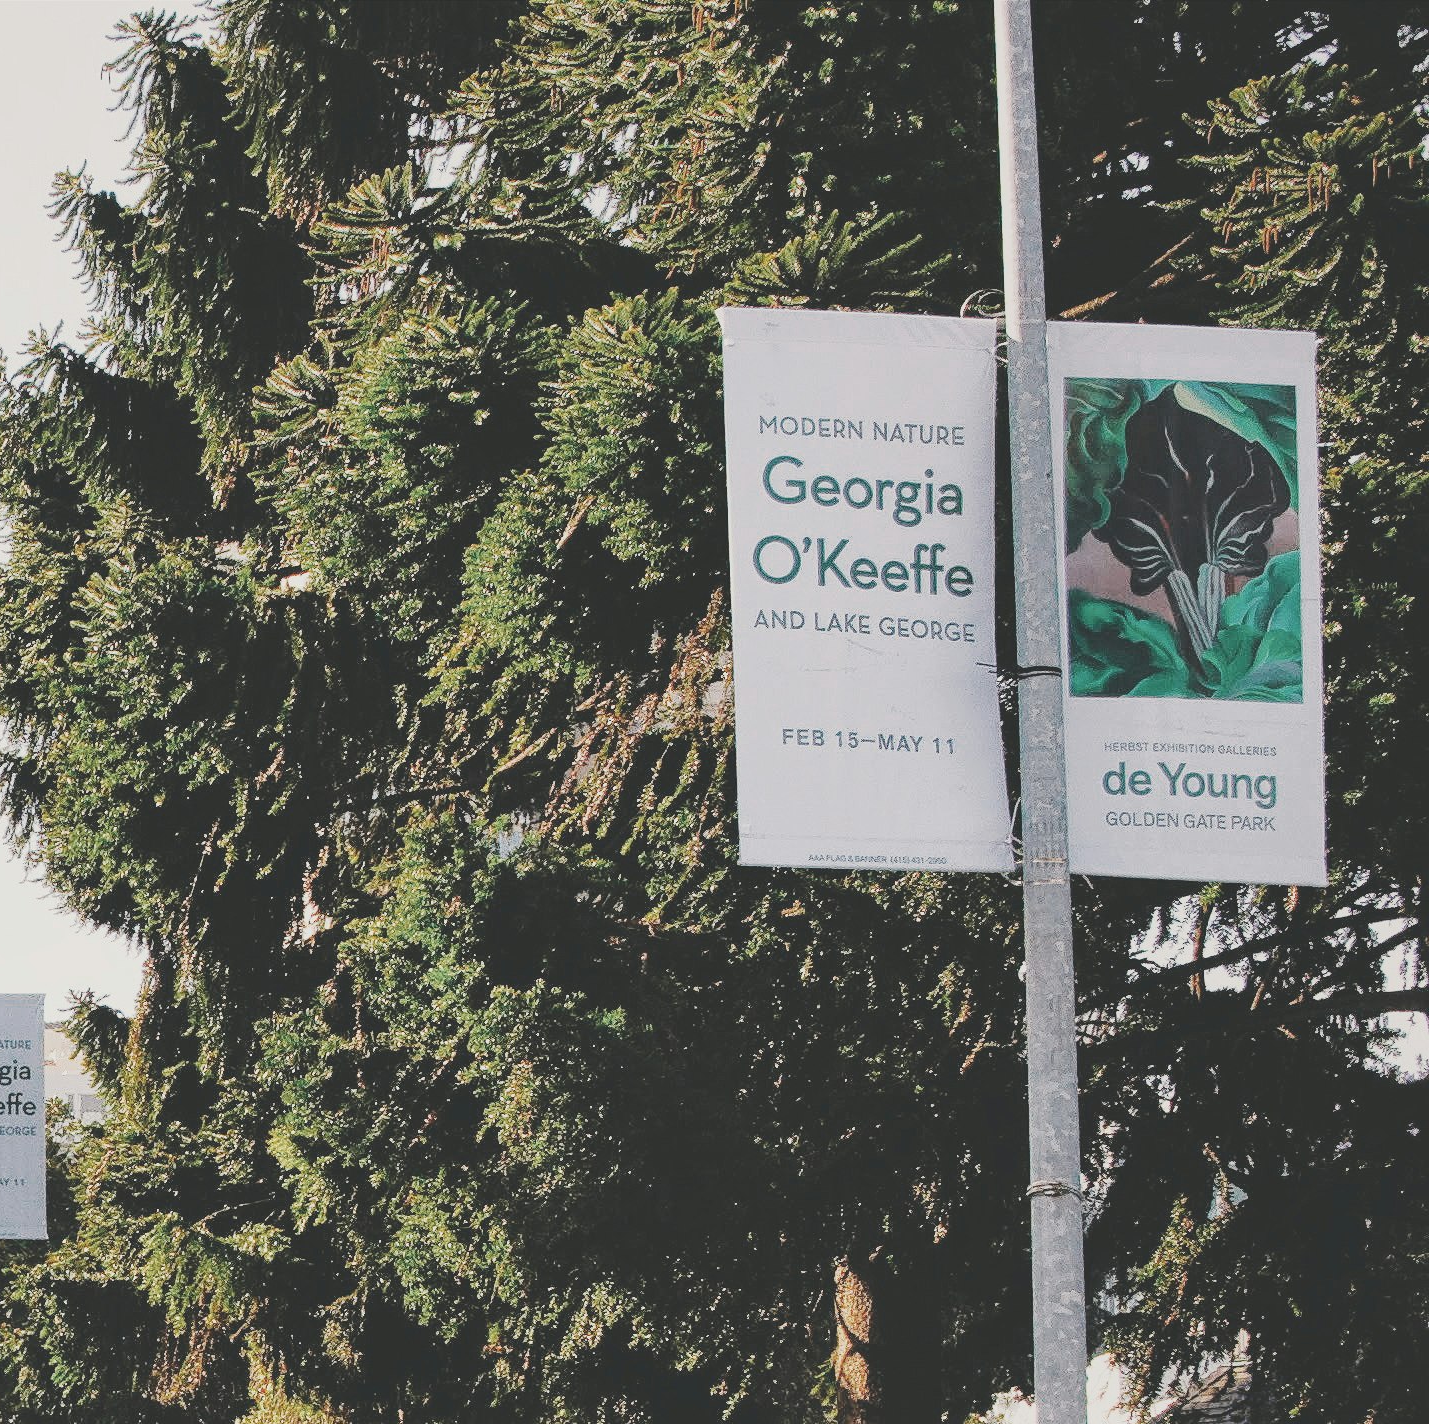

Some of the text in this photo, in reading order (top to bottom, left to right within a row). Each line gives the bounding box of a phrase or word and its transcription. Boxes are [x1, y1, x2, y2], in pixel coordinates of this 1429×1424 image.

[759, 415, 965, 446] MODERN NATURE
[762, 455, 964, 528] Georgia
[752, 534, 975, 598] O'Keeffe
[753, 609, 977, 643] AND LAKE GEORGE
[782, 728, 825, 746] FEB
[932, 737, 955, 754] 11
[1104, 741, 1277, 756] HERBST EXHIBITION GALLERIES
[1102, 761, 1277, 810] de Young
[1105, 811, 1276, 831] GOLDEN GATE PARK
[826, 854, 846, 863] FLAG
